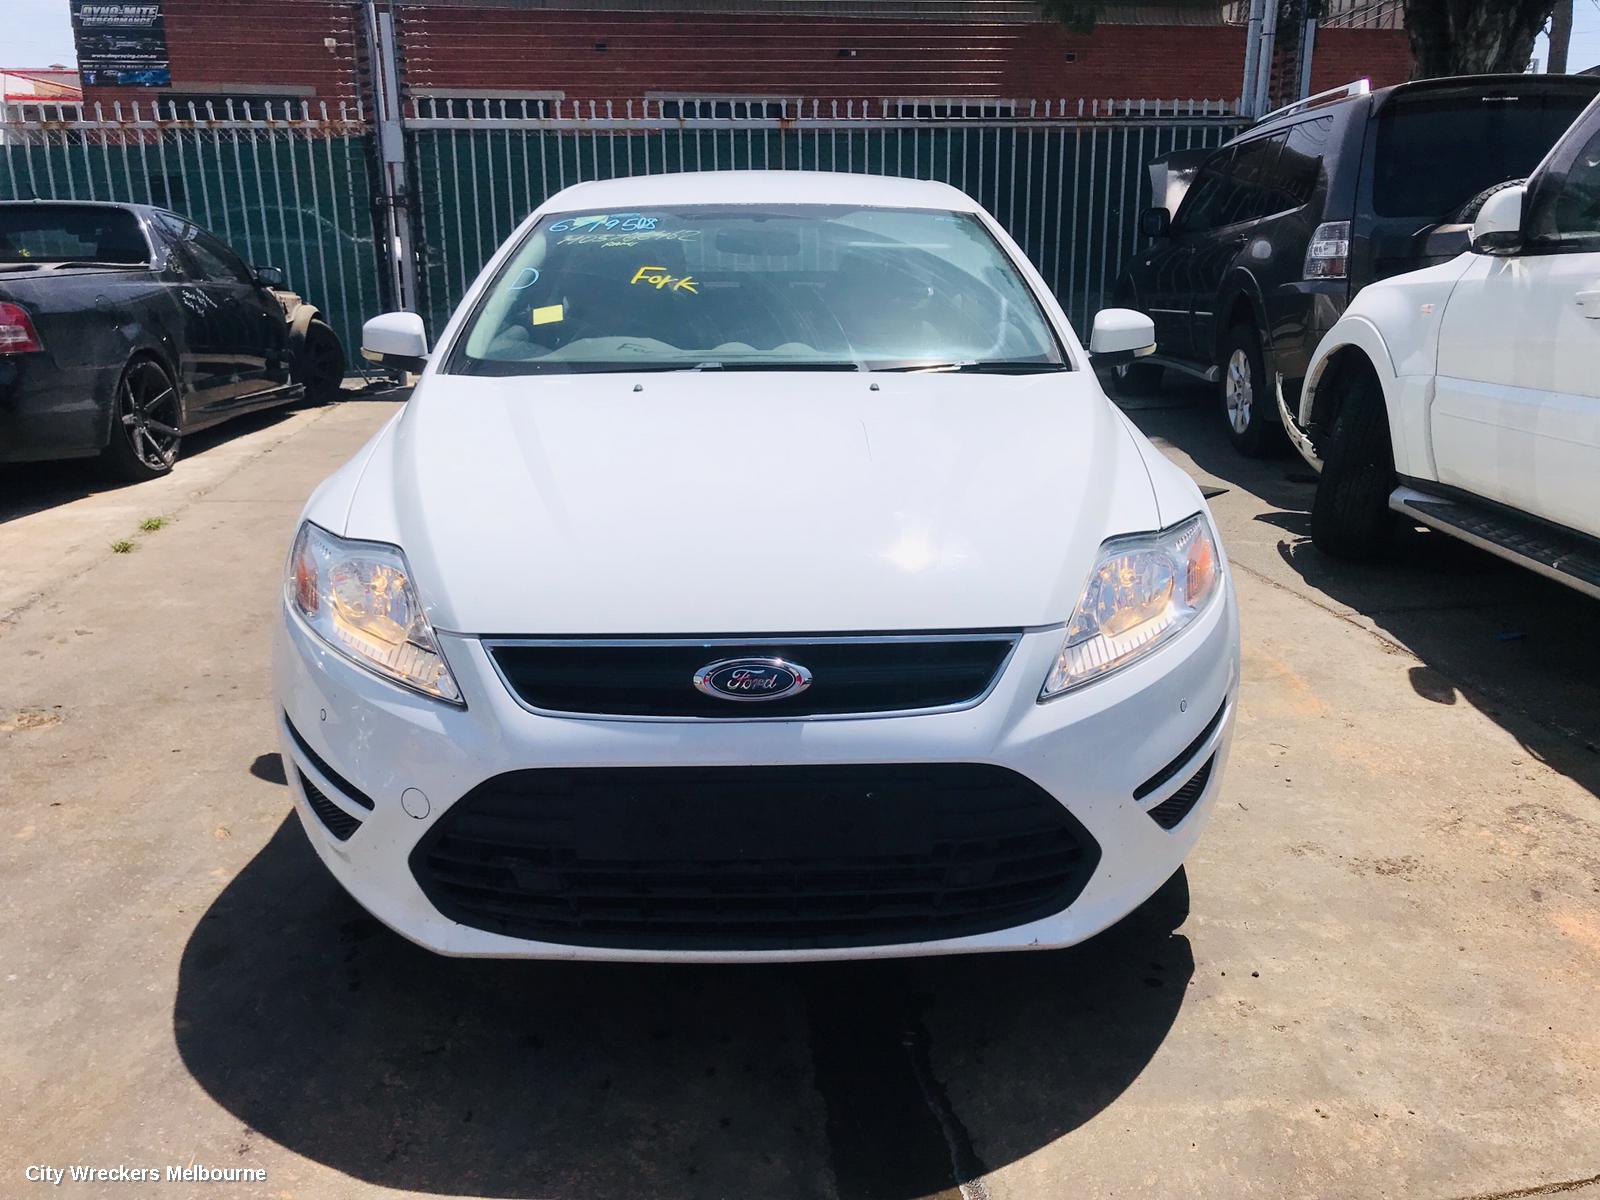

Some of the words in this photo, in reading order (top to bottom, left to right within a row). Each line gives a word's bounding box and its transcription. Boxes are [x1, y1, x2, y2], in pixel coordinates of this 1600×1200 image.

[82, 6, 157, 16] DYNO-MITE
[630, 265, 699, 295] Fork
[726, 668, 778, 690] Ford
